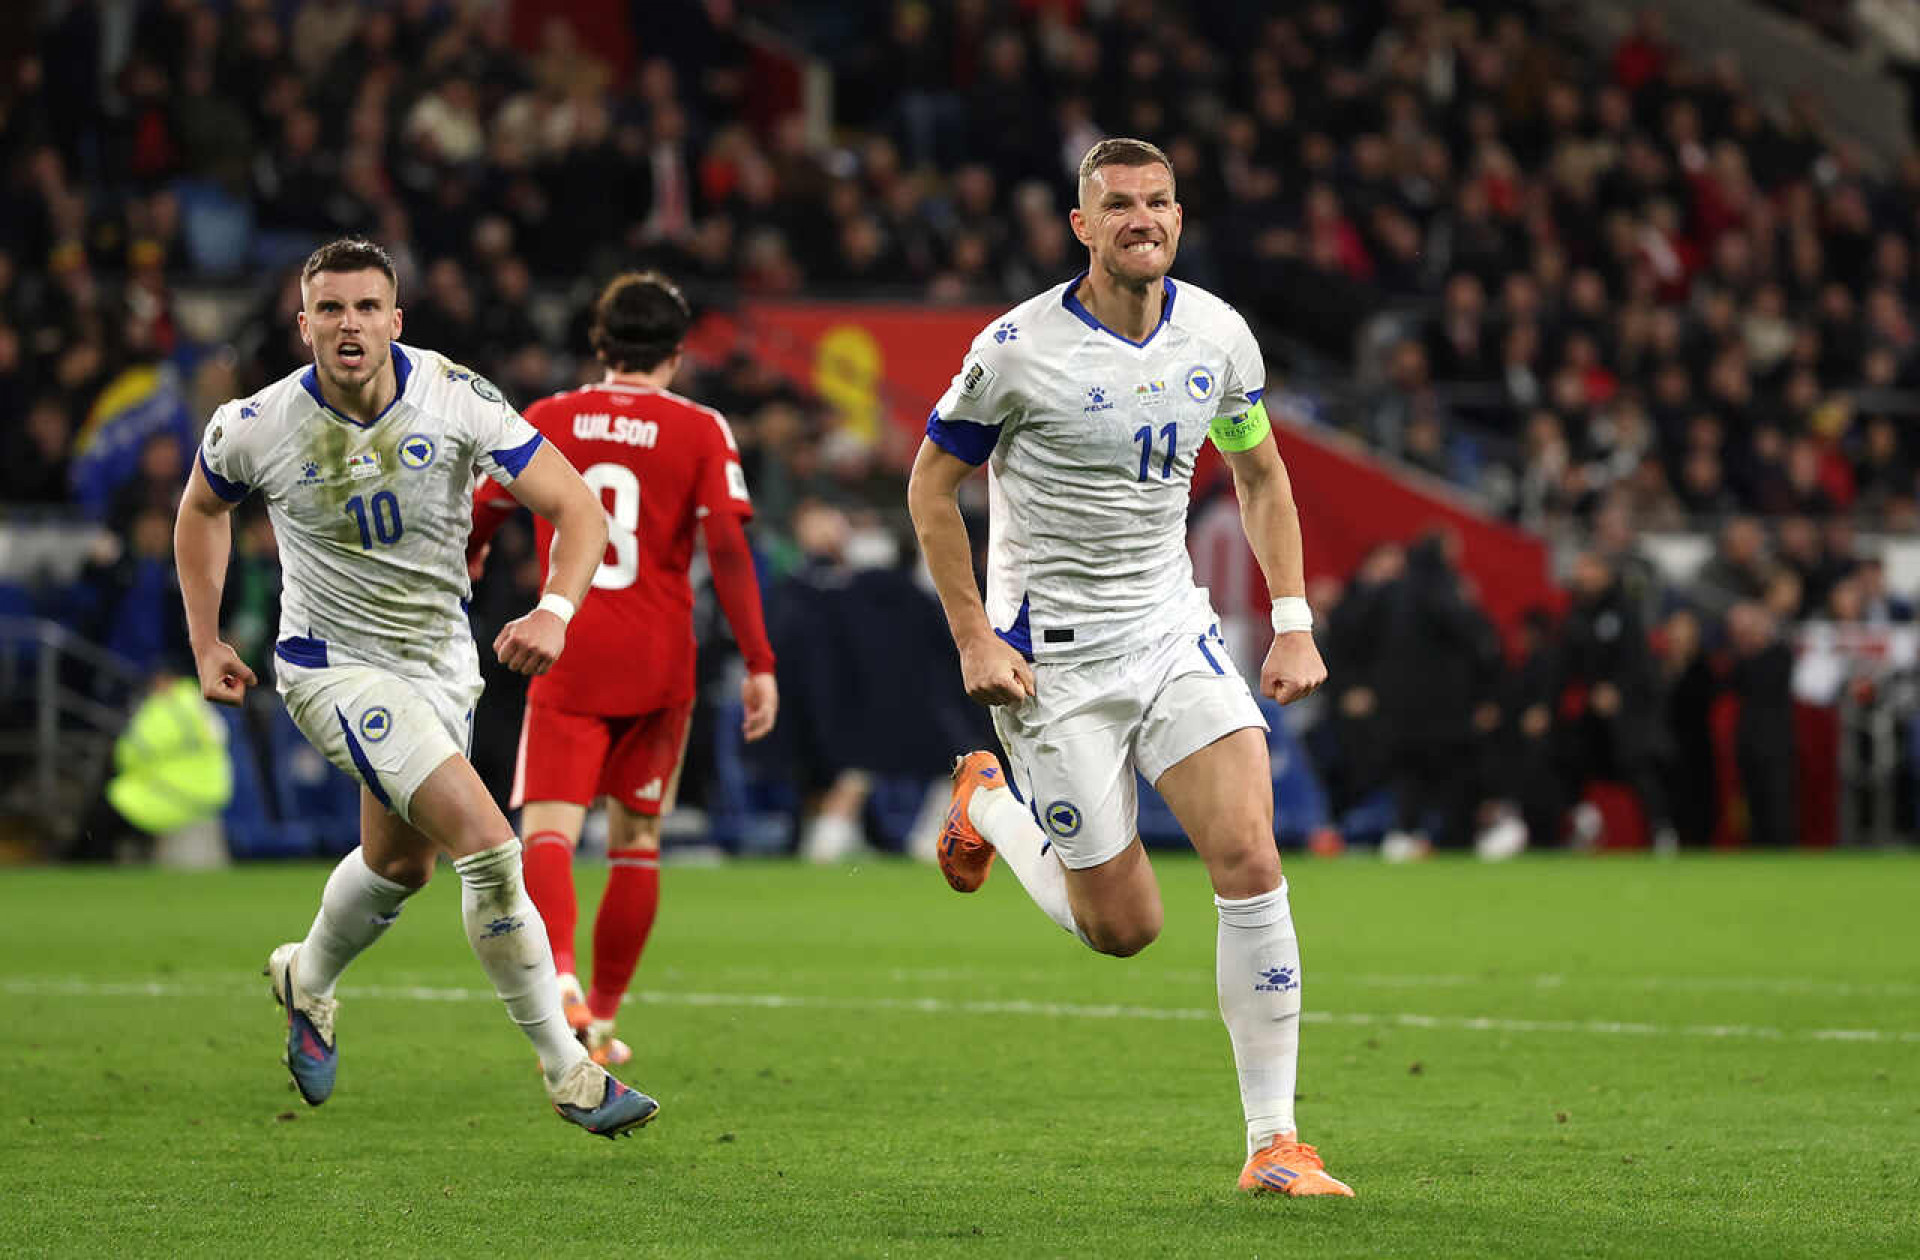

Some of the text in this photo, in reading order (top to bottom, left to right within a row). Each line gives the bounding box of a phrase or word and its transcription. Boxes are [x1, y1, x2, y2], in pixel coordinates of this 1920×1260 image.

[573, 413, 659, 449] WILSON
[1133, 421, 1177, 482] 11
[345, 490, 405, 550] 10
[582, 462, 640, 590] 8
